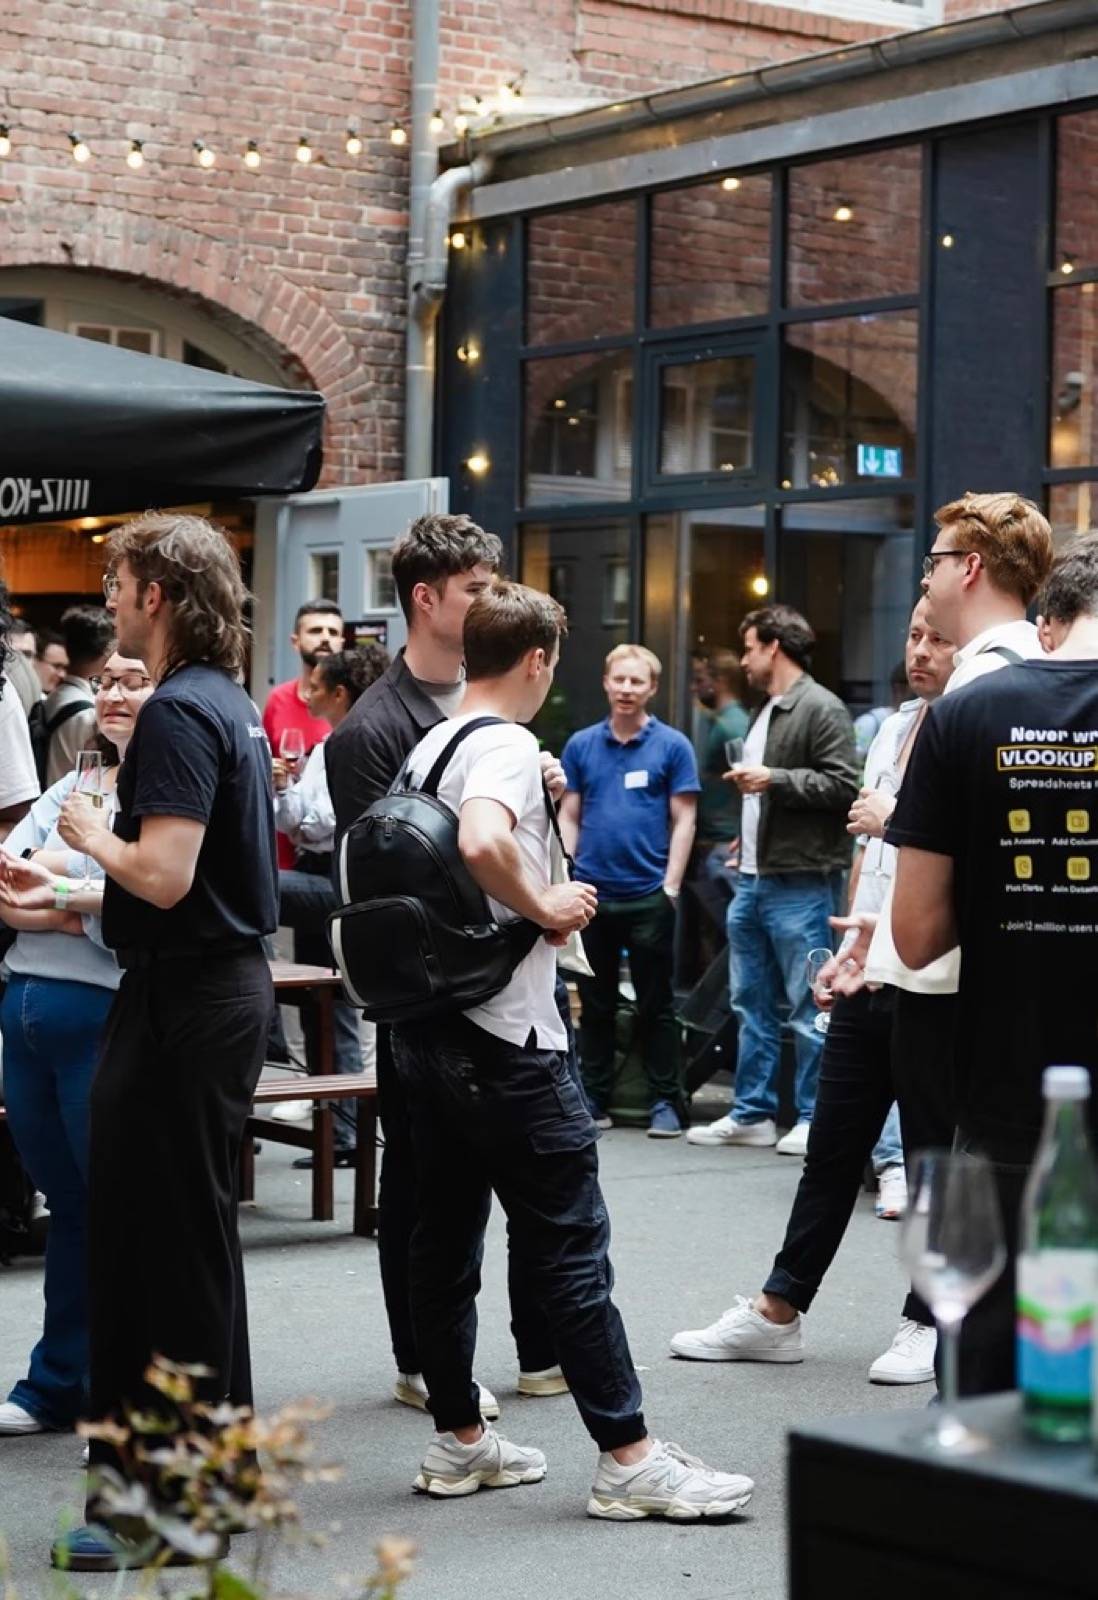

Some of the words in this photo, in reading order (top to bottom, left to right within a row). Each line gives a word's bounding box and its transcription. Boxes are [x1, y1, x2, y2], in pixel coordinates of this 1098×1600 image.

[1011, 727, 1068, 742] Never
[1001, 749, 1095, 767] VLOOKUP
[1009, 777, 1093, 790] Spreadsheets
